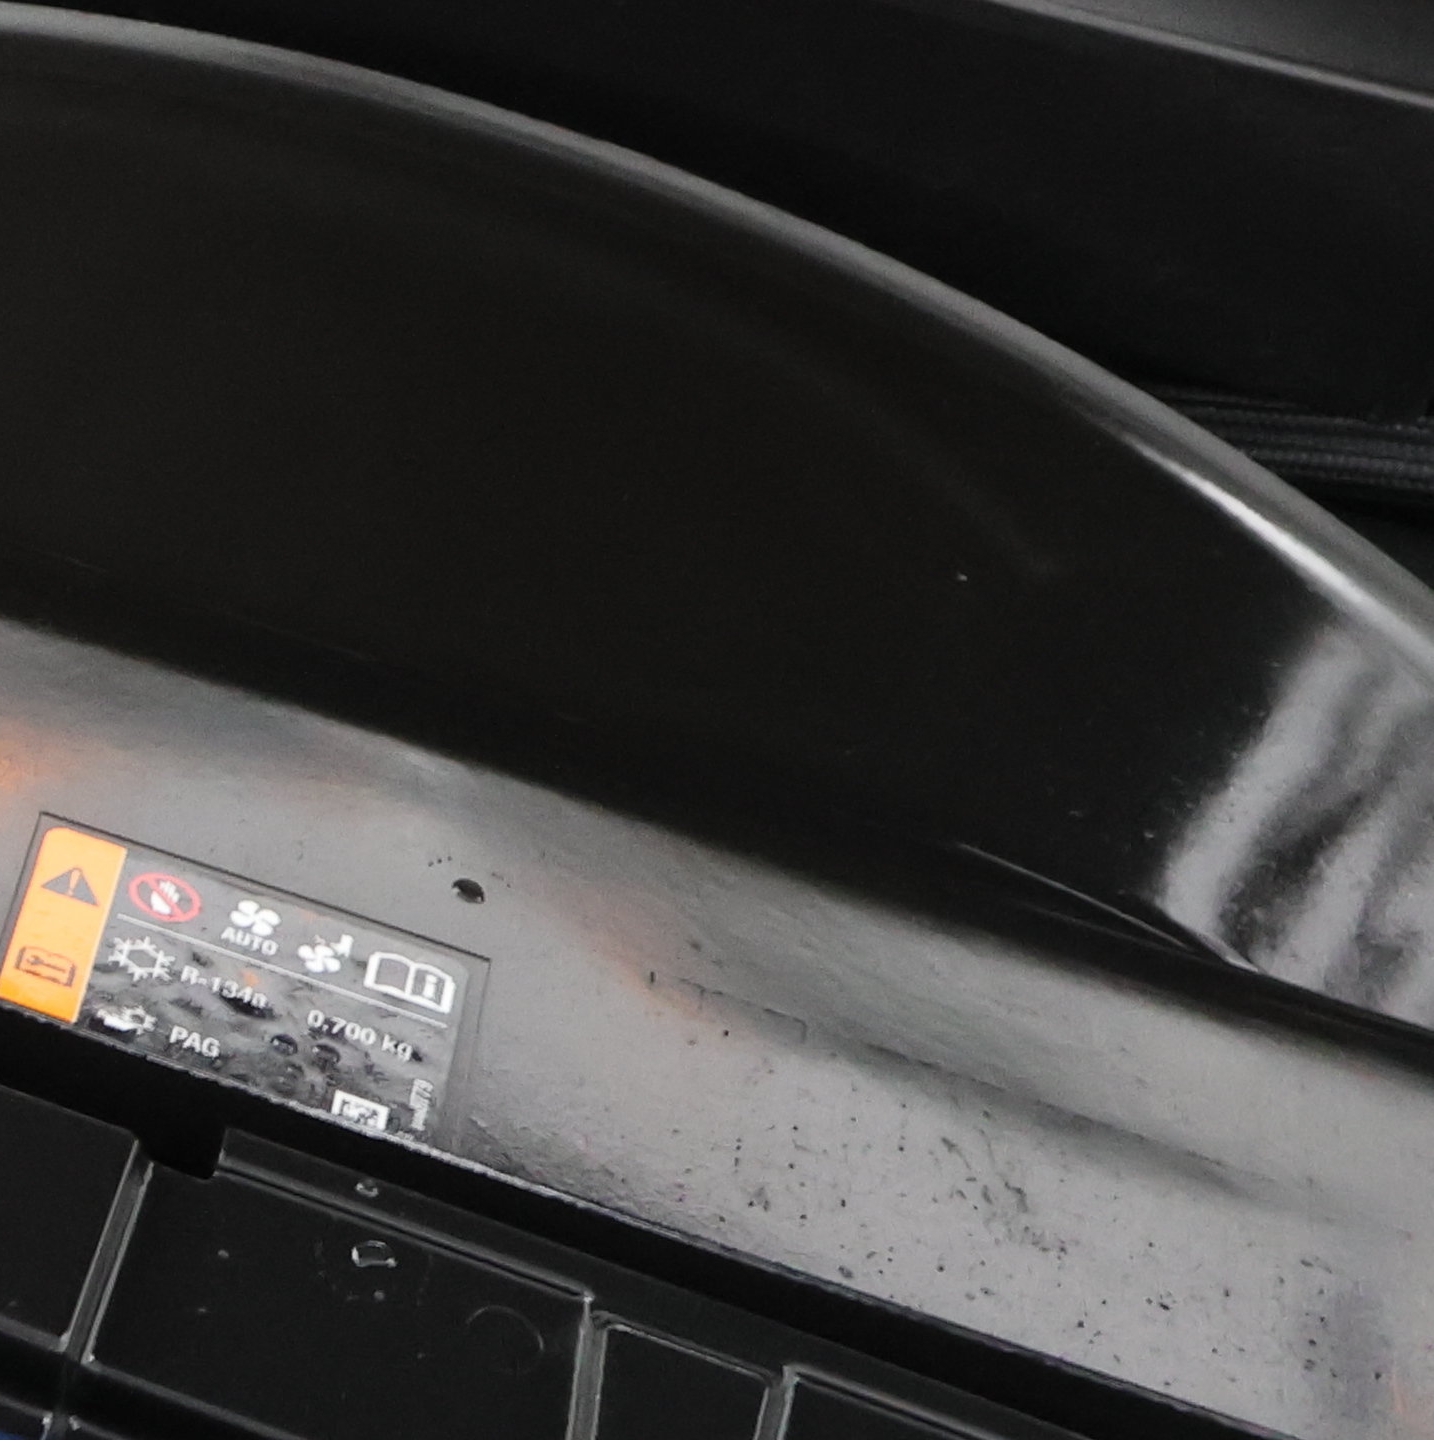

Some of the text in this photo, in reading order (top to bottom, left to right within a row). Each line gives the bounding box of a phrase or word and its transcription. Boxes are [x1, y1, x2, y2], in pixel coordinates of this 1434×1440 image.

[221, 927, 278, 956] AUTO
[181, 965, 268, 1008] R-134a
[381, 1034, 413, 1062] kg
[170, 1026, 220, 1058] PAG
